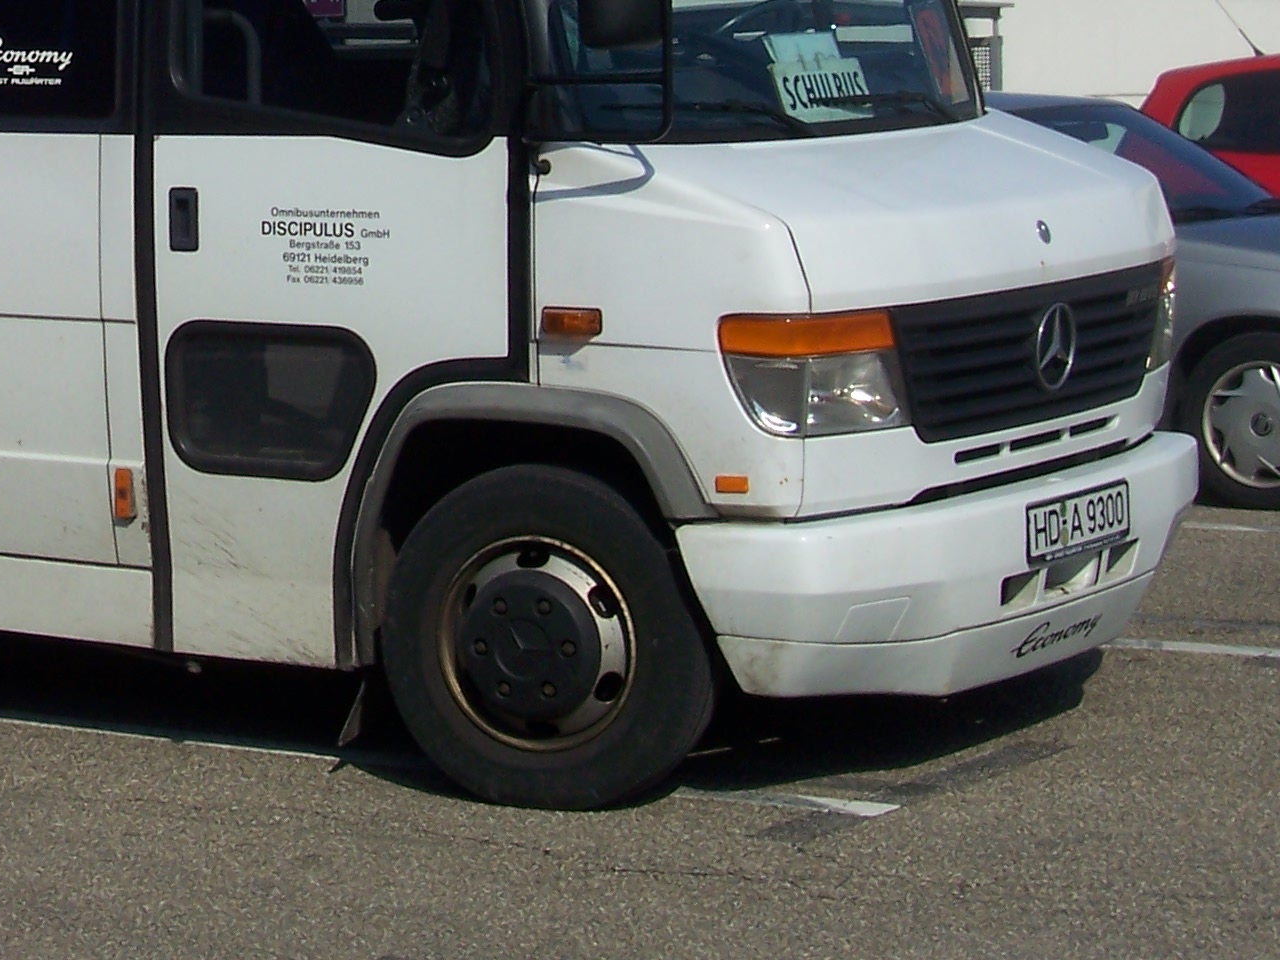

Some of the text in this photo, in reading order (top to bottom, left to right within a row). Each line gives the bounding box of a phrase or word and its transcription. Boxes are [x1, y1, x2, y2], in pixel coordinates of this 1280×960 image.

[270, 206, 380, 219] Omnibusunternehmen
[261, 221, 390, 239] DISCIPULUS GmbH
[289, 239, 361, 250] Bergstraße 153
[282, 252, 369, 266] 69121 Heidelberg
[286, 274, 301, 284] Fax
[1086, 490, 1124, 534] 9300
[1010, 613, 1103, 659] Economy
